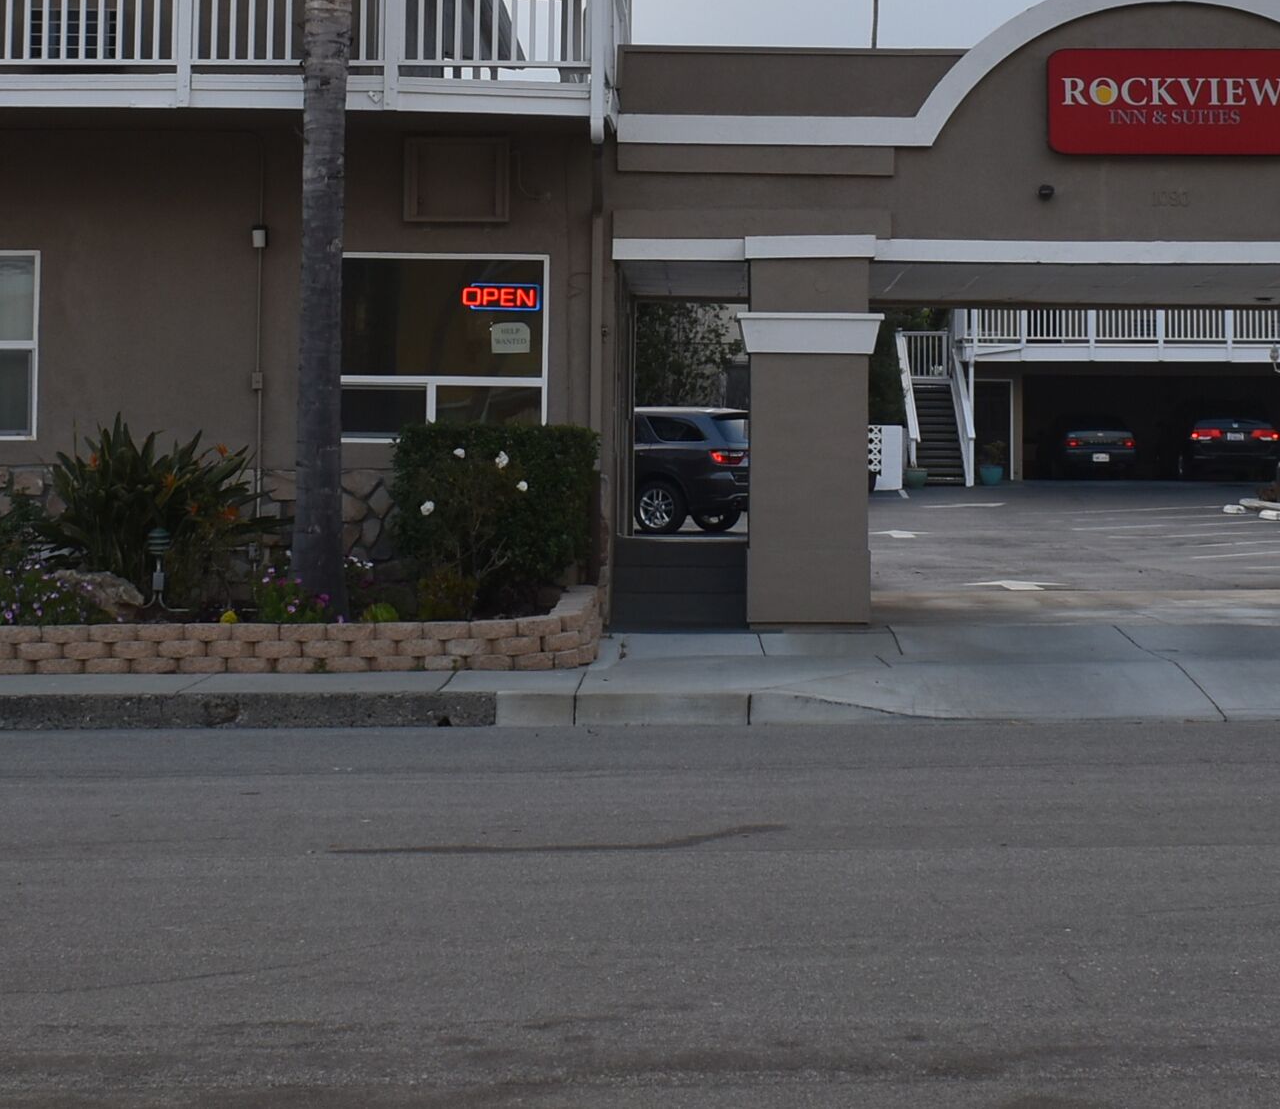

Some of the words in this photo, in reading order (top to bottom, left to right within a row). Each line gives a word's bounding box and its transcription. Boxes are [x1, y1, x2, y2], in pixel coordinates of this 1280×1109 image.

[1108, 109, 1146, 124] INN
[1152, 109, 1167, 124] &
[1171, 109, 1241, 124] SUITES
[462, 287, 535, 307] OPEN
[495, 338, 527, 346] WANTED
